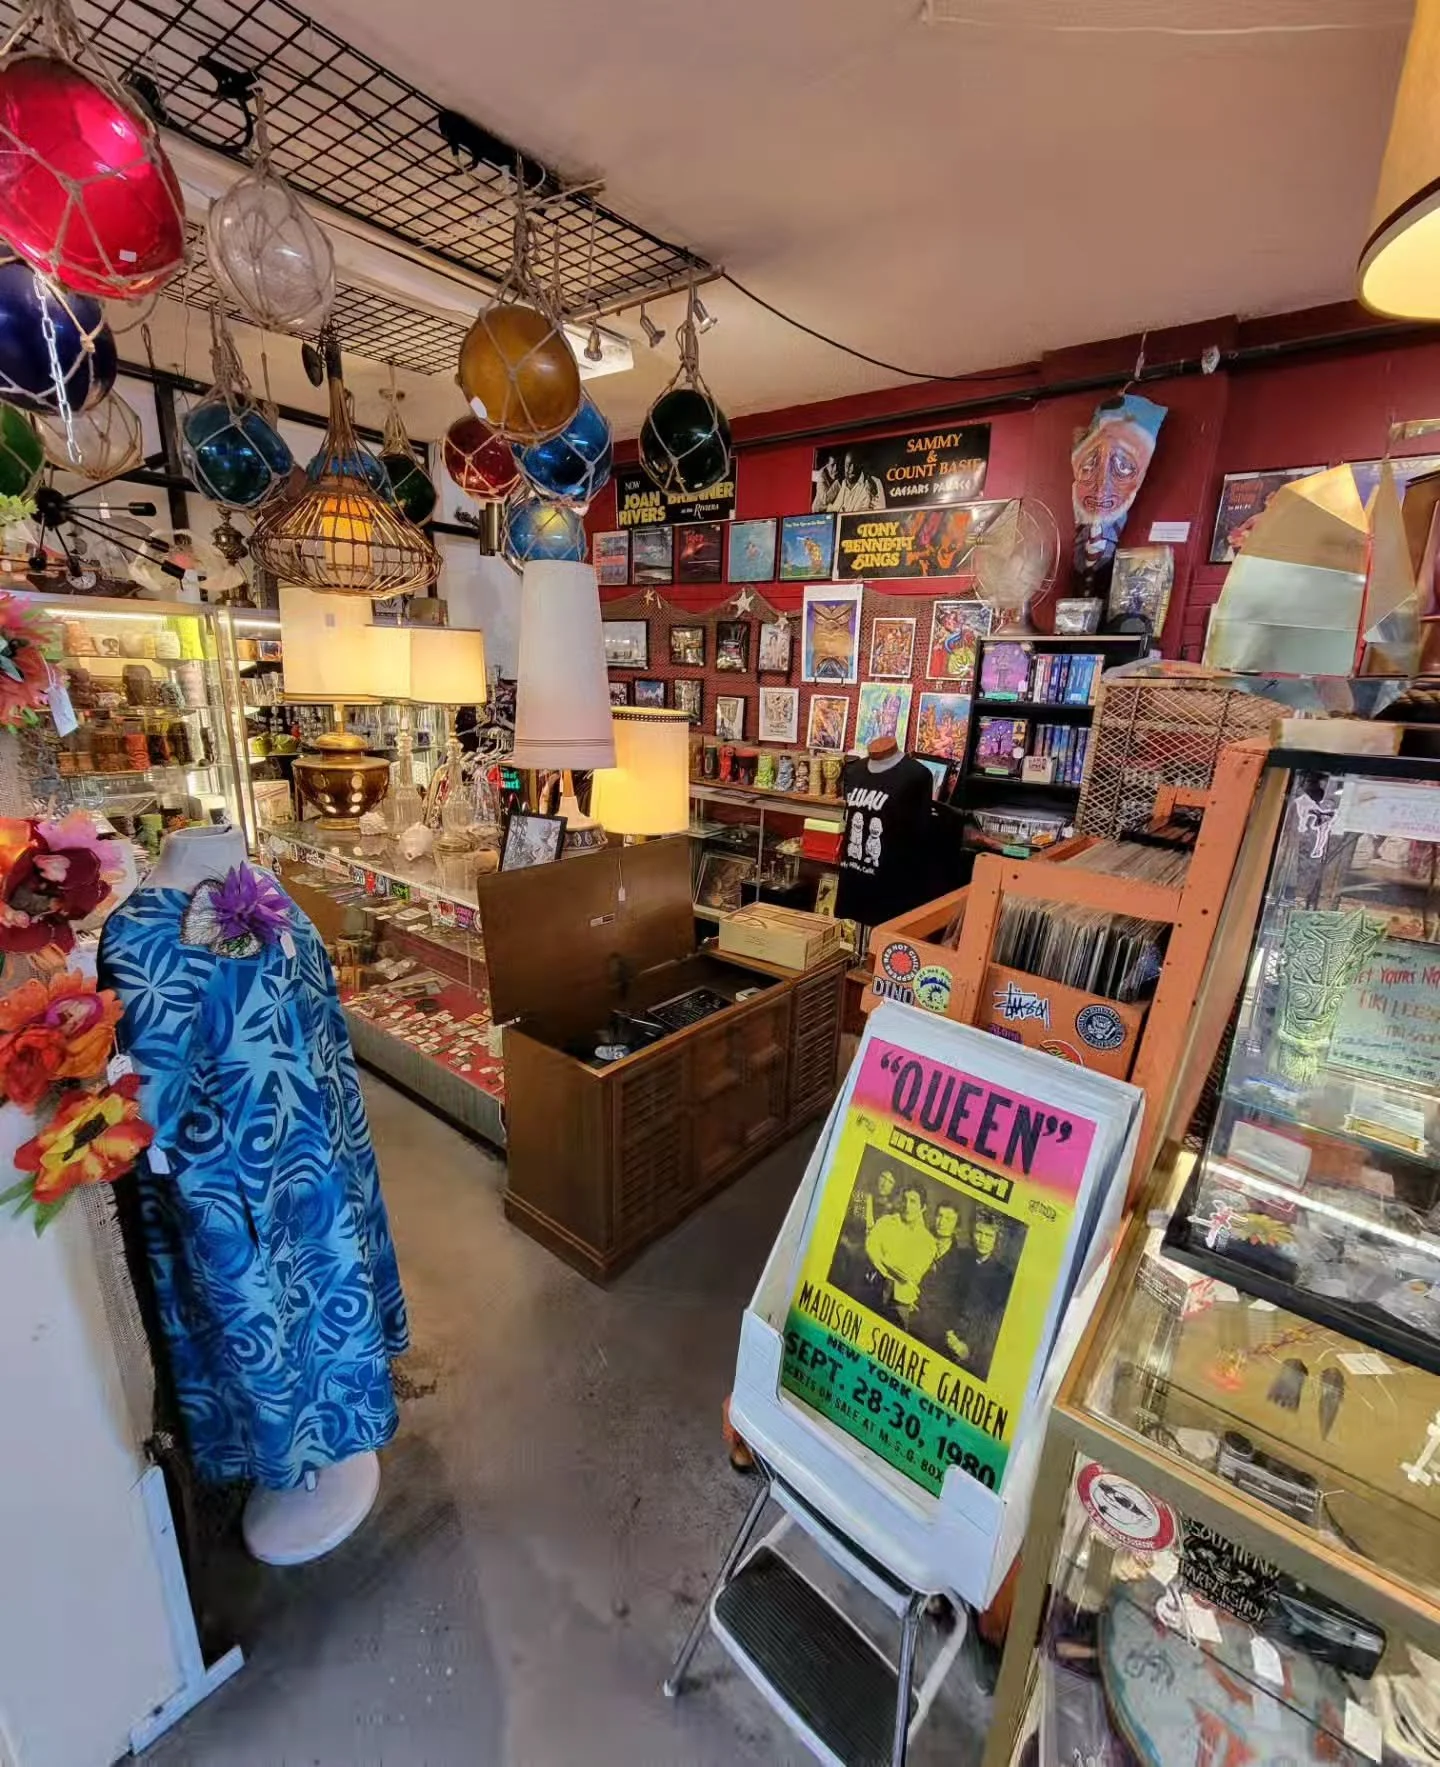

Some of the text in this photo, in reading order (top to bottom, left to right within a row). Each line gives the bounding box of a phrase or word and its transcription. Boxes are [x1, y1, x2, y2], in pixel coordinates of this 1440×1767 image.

[906, 433, 963, 453] SAMMY
[926, 450, 938, 463] &
[886, 463, 936, 481] COUNT
[624, 480, 641, 491] NOW
[889, 483, 929, 498] CAESARS
[624, 491, 660, 511] JOAN
[619, 506, 666, 526] RIVERS
[857, 522, 900, 538] TONY
[841, 536, 915, 554] BENNETT
[850, 552, 900, 571] SINGS
[847, 787, 889, 811] LUAU
[892, 944, 908, 952] HOT
[799, 1280, 1009, 1441] MADISON SQUARE GARDEN
[826, 1333, 959, 1431] NEW YORK CITY
[785, 1330, 997, 1490] SEPT. 28-30, 1980
[834, 1394, 859, 1421] SALE
[862, 1413, 875, 1434] AT
[920, 1458, 944, 1484] BOX
